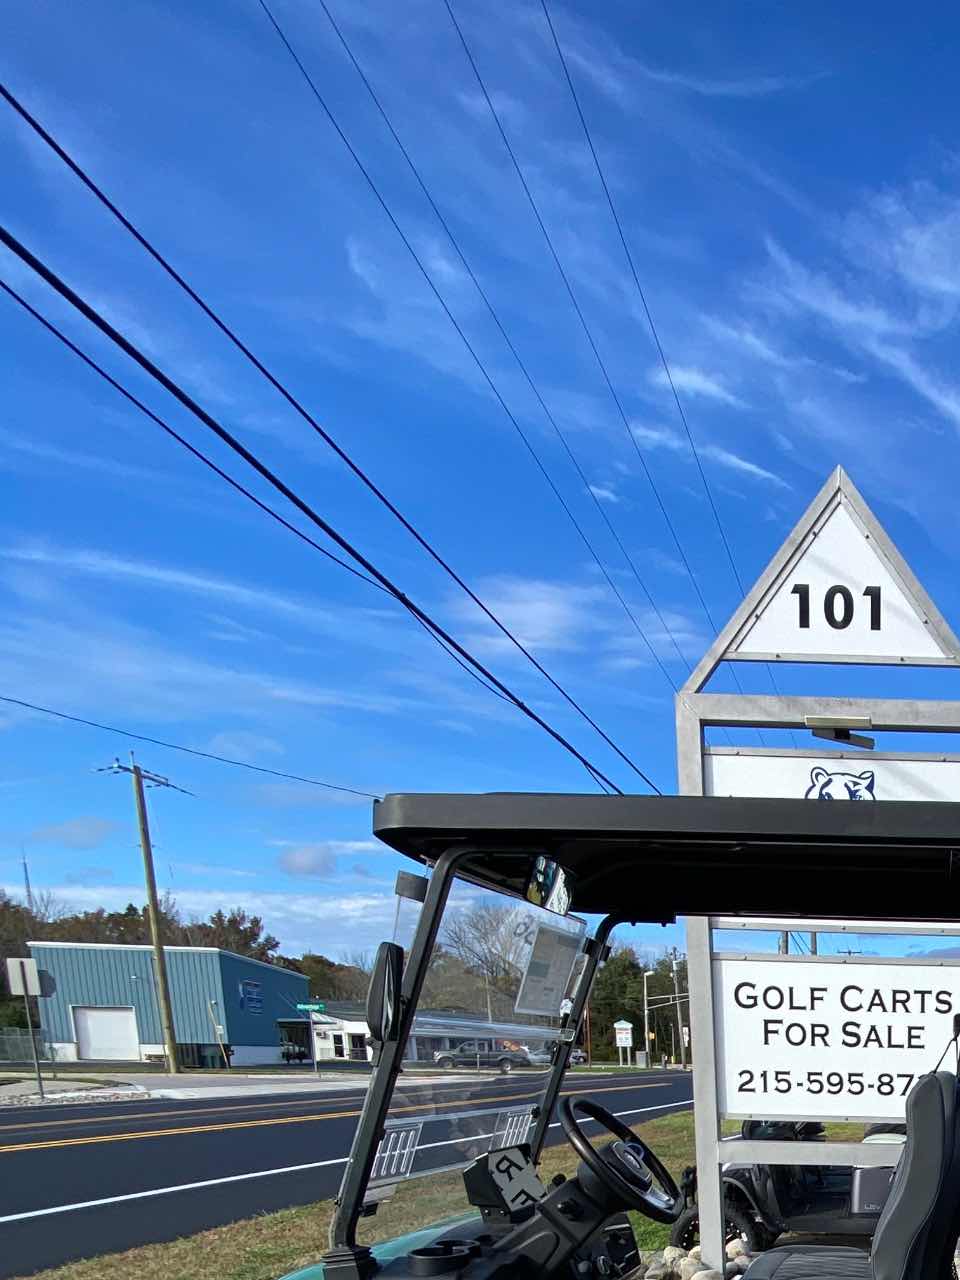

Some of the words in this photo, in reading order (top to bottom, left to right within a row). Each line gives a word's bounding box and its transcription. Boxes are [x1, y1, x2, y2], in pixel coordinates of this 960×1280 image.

[791, 583, 881, 631] 101
[734, 982, 828, 1011] GOLF
[840, 985, 953, 1014] CARTS
[763, 1019, 830, 1047] FOR
[841, 1021, 925, 1049] SALE
[737, 1069, 922, 1097] 215-595-87
